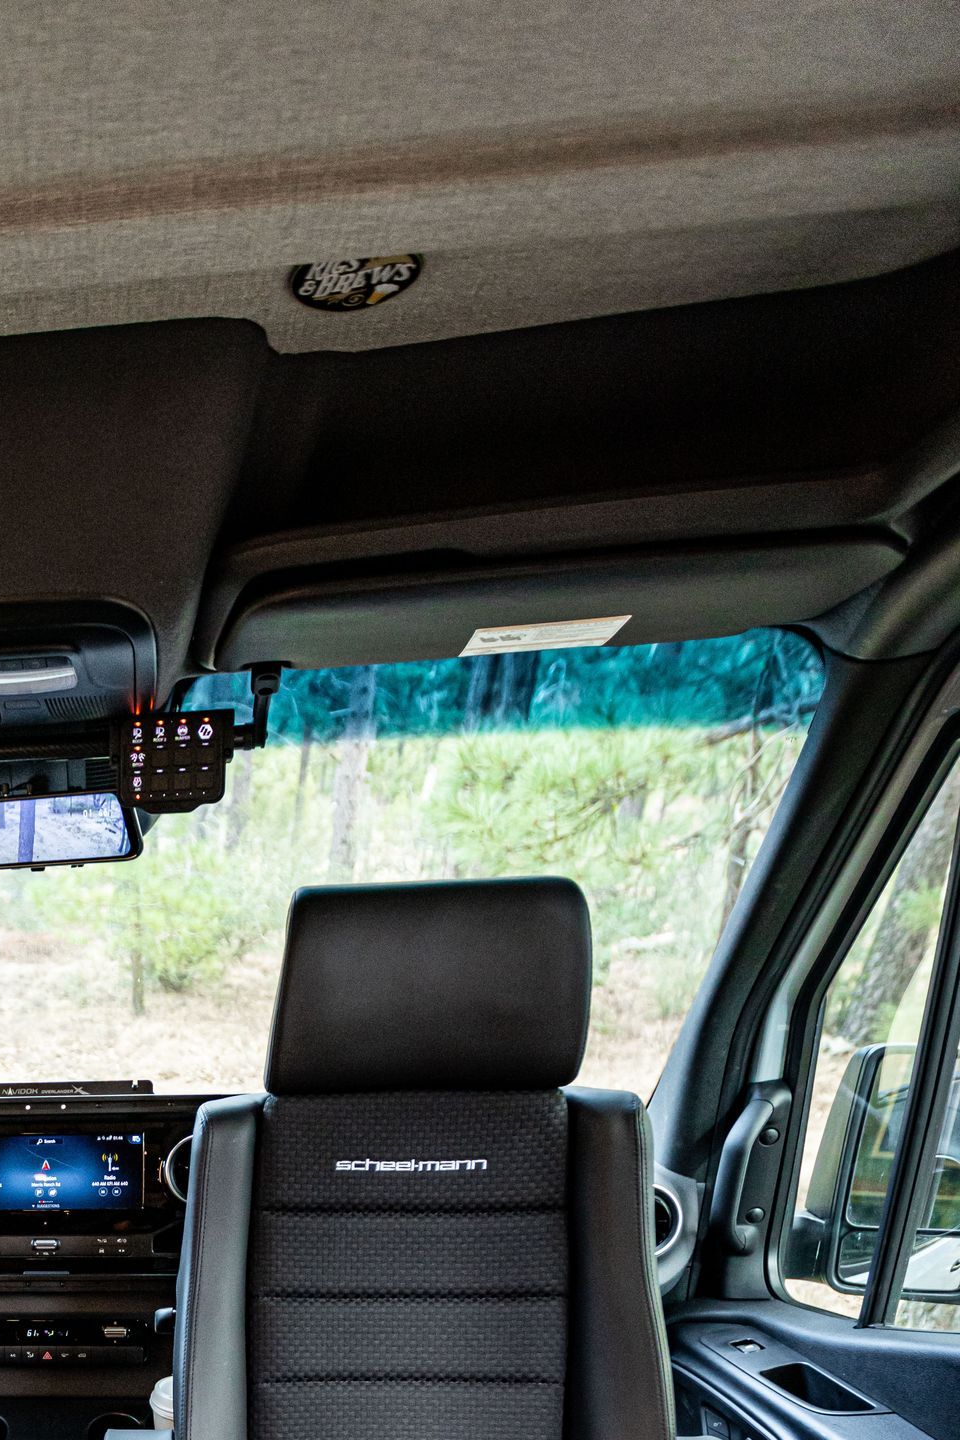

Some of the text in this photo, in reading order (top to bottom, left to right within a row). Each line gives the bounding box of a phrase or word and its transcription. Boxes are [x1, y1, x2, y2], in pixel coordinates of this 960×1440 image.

[298, 263, 417, 299] & BREWS
[335, 1158, 488, 1172] scheel-mann
